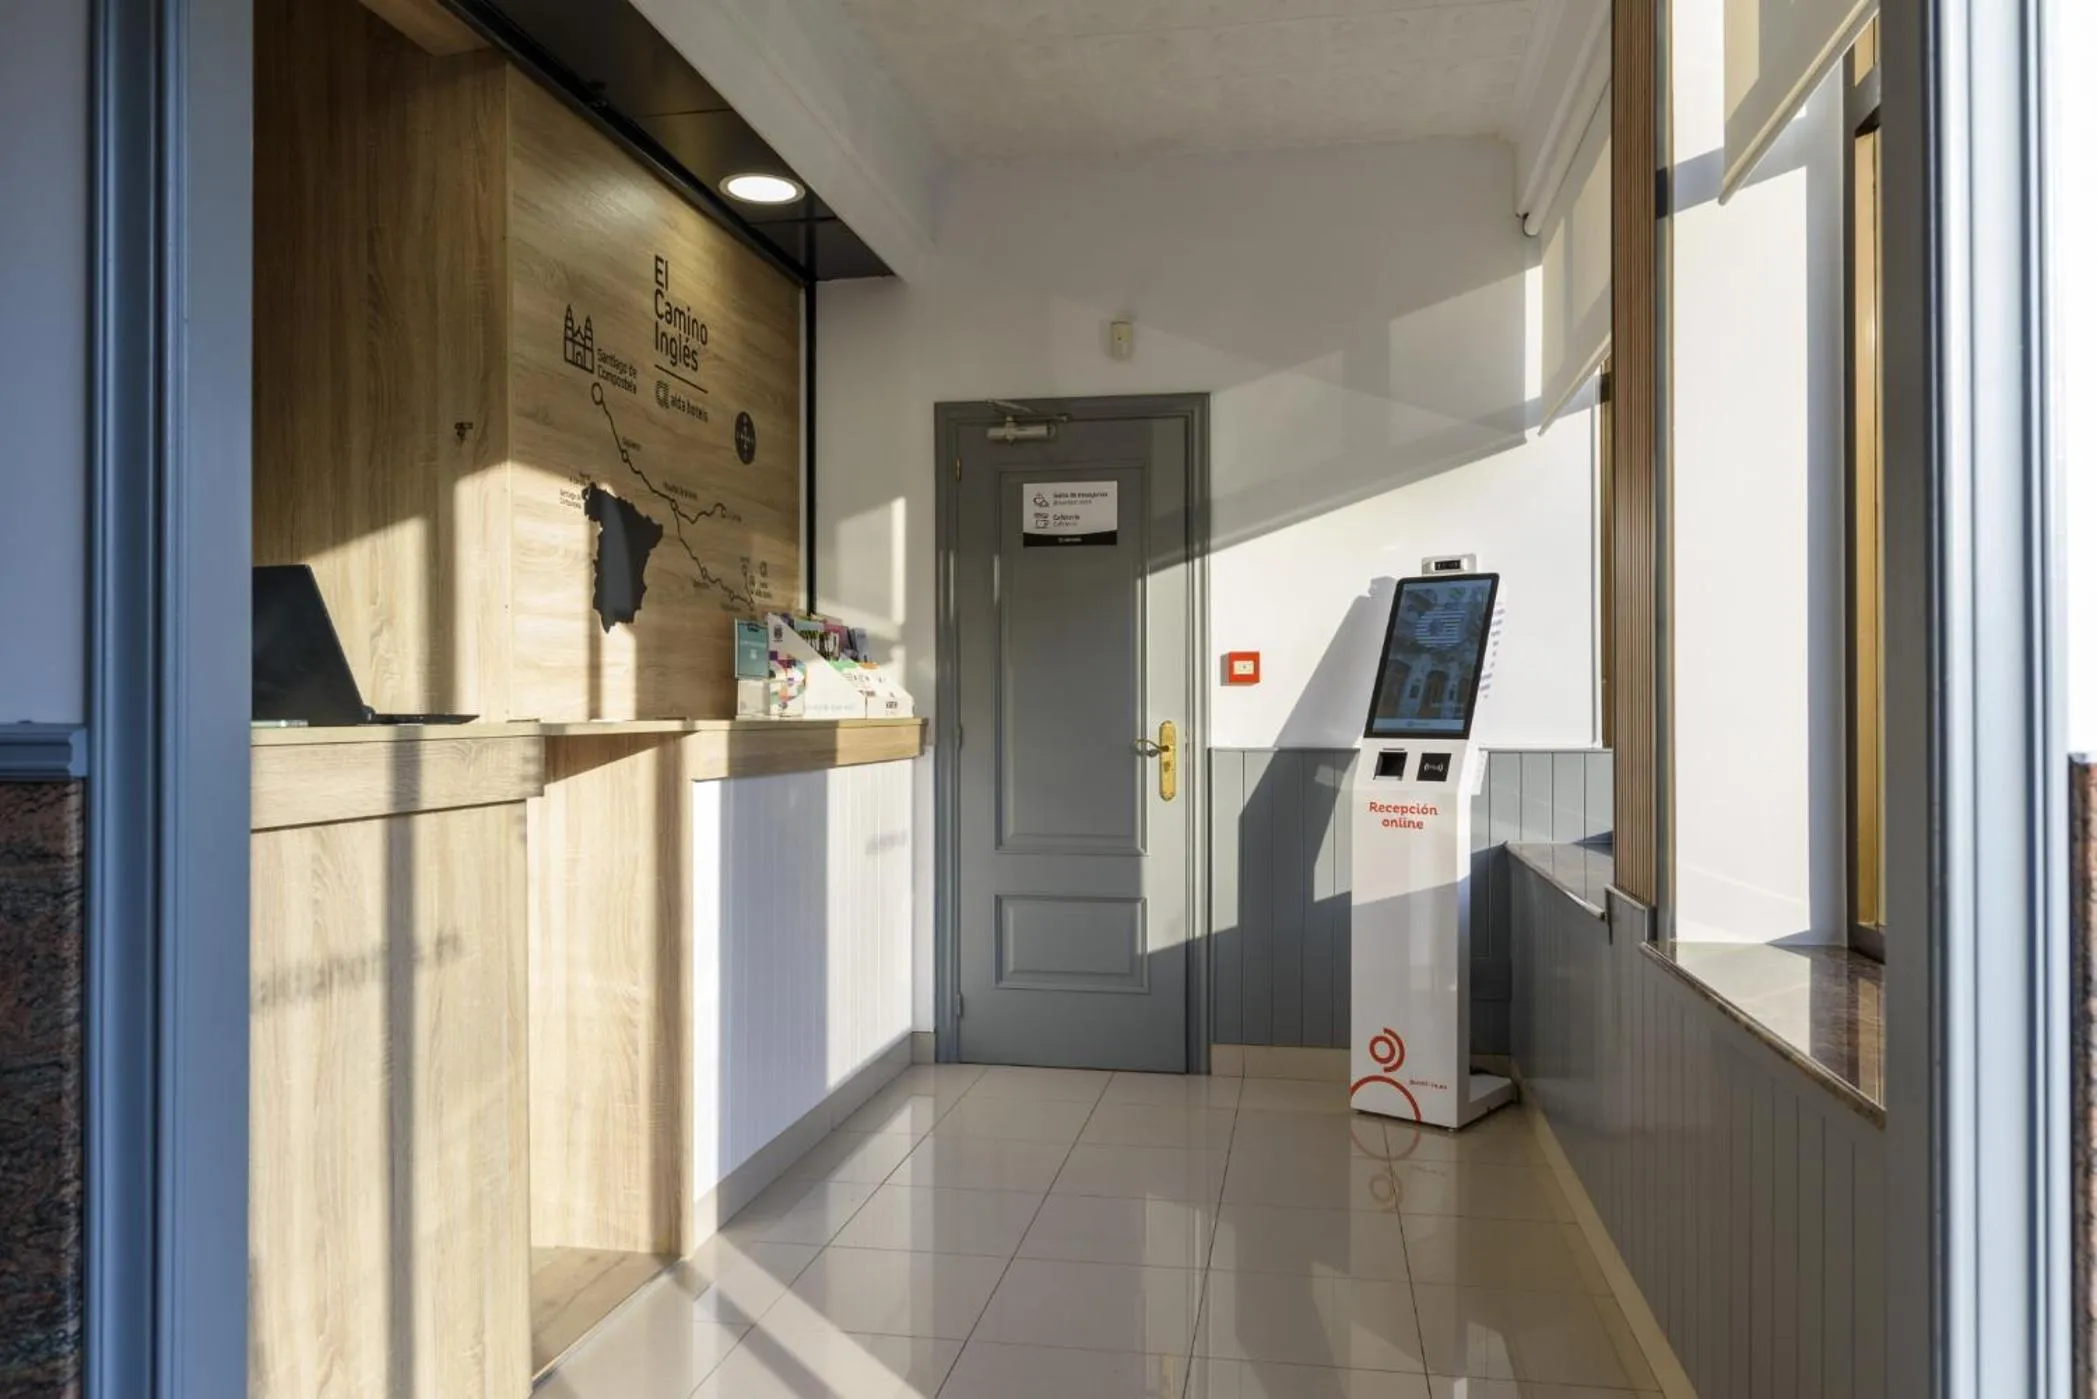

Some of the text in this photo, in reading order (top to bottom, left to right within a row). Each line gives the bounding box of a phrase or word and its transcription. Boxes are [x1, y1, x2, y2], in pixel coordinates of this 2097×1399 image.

[655, 254, 669, 291] El
[654, 287, 708, 346] Camino
[597, 347, 628, 374] Santiago
[655, 320, 698, 372] Inglés
[597, 363, 637, 395] Compostela
[1369, 802, 1438, 816] Recepción
[1381, 817, 1424, 829] online
